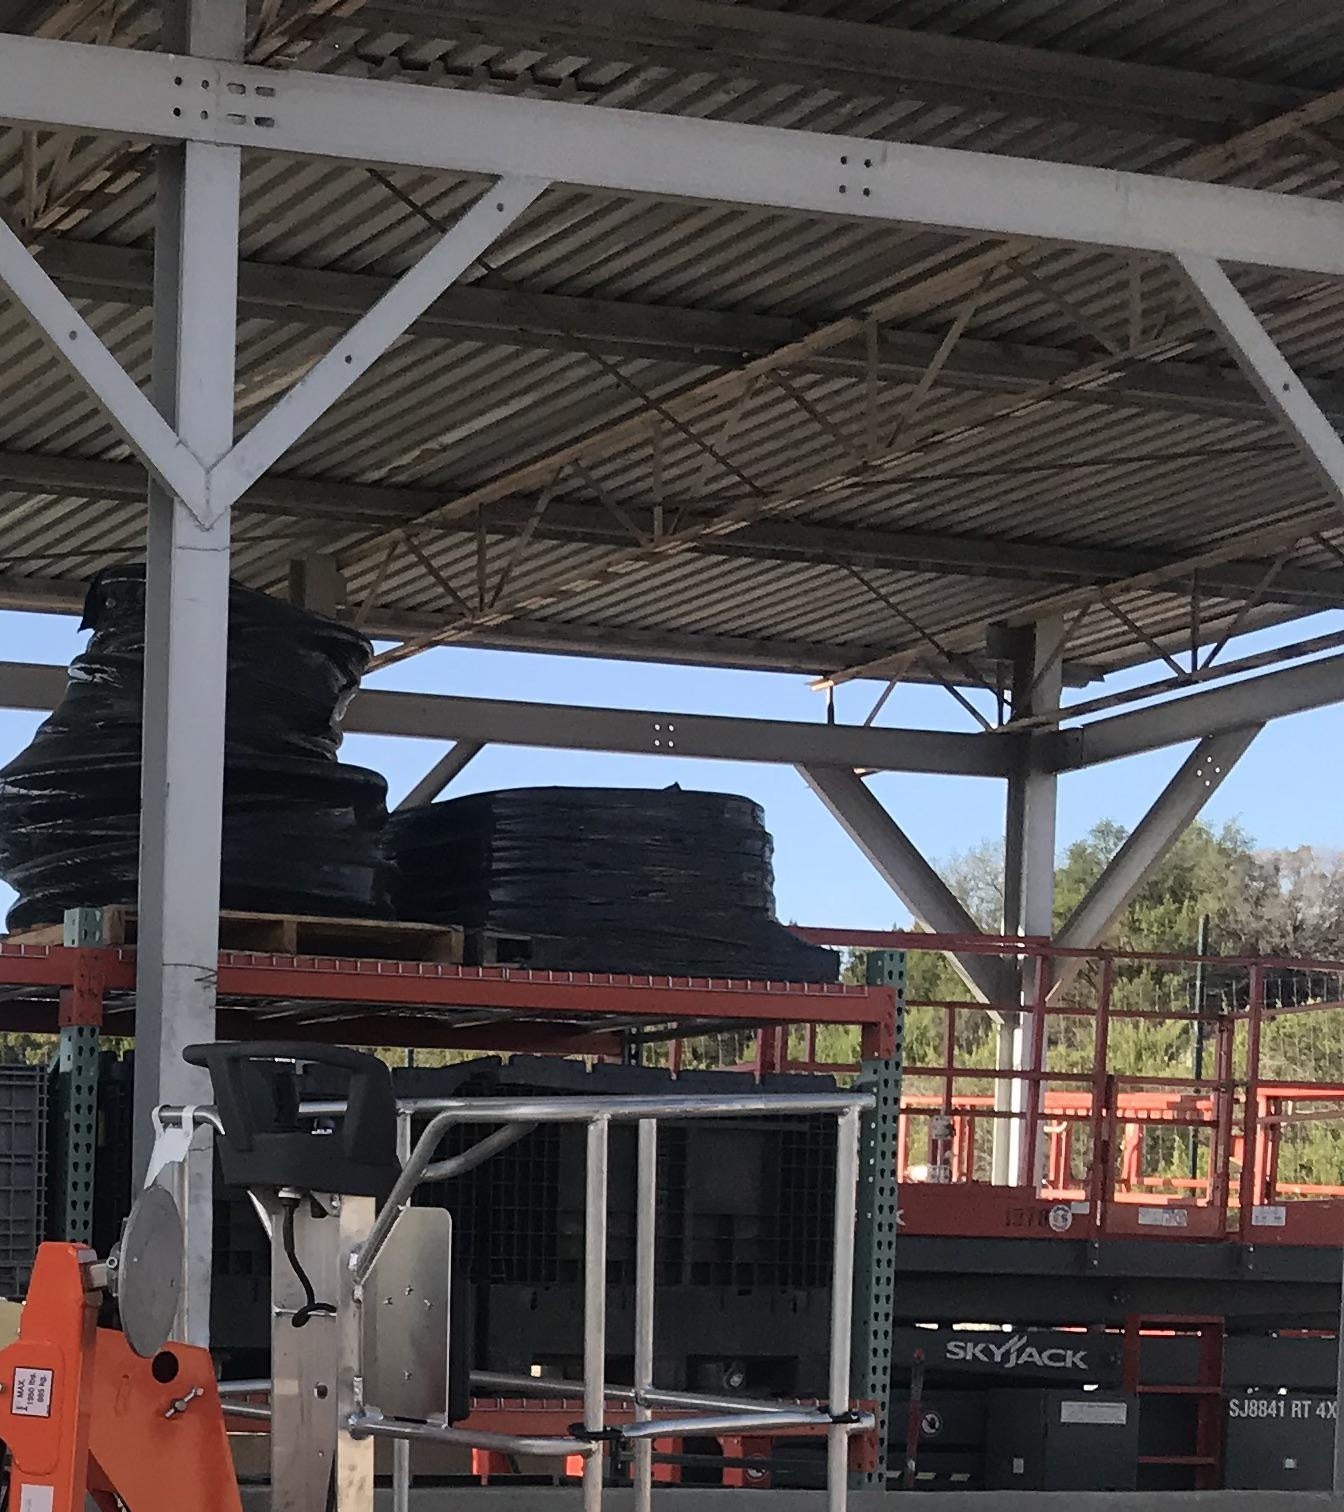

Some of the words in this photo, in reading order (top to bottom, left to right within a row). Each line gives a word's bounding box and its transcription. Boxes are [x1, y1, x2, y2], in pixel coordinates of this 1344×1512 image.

[945, 1334, 1089, 1370] SKYJACK
[1229, 1398, 1285, 1418] SJ8841
[1291, 1400, 1312, 1418] RT
[1315, 1400, 1337, 1419] 4X
